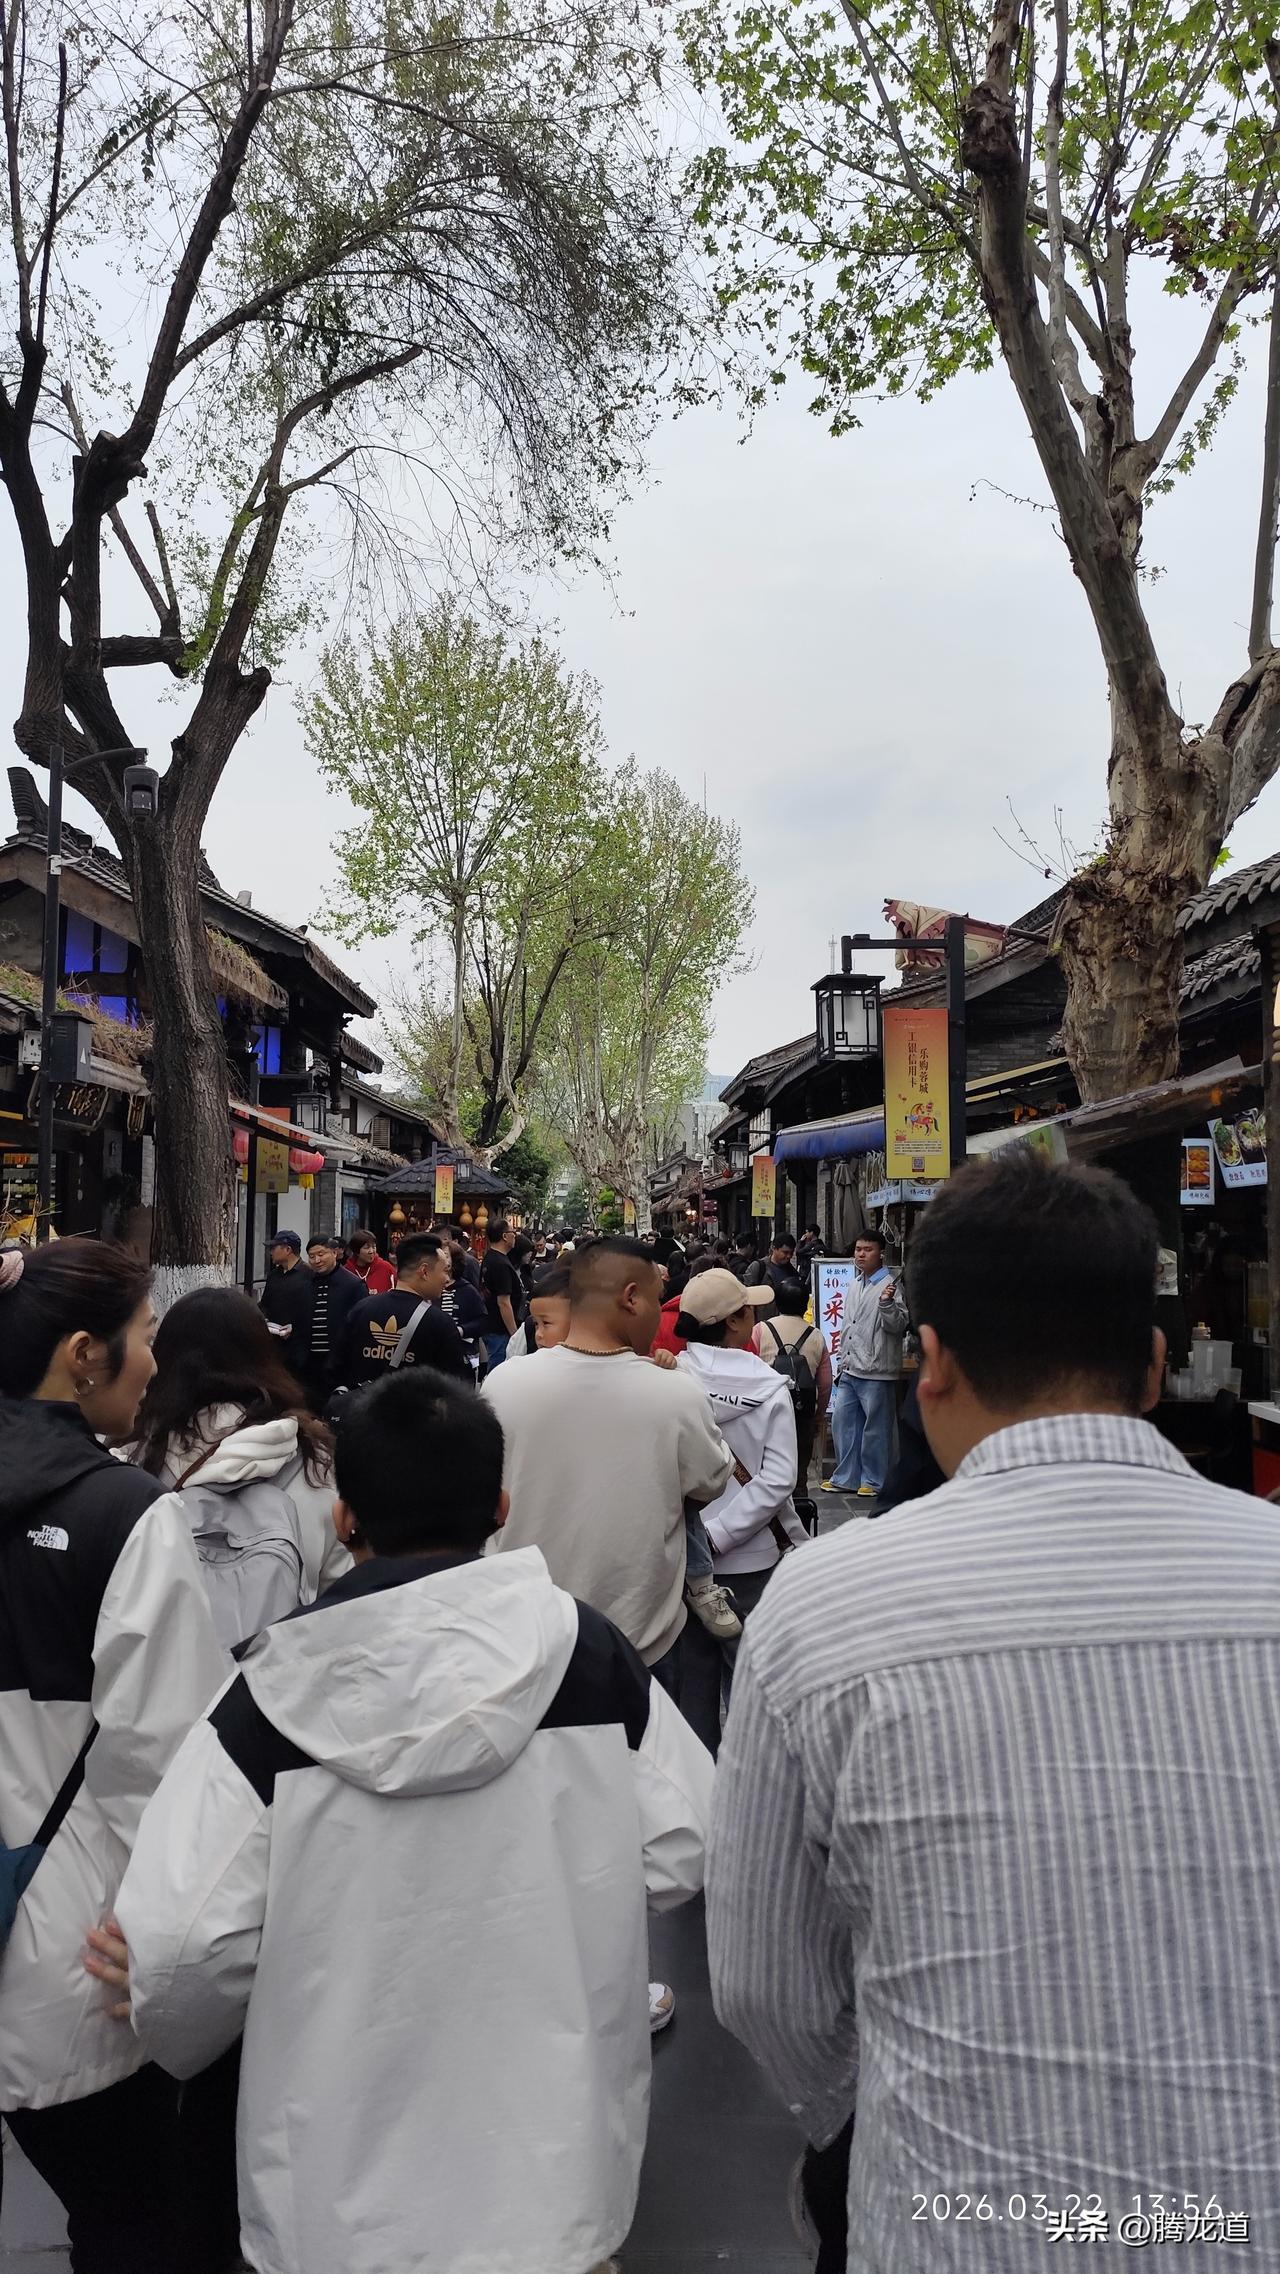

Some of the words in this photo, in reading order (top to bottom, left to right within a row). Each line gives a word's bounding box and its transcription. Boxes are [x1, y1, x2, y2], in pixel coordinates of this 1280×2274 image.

[908, 1031, 917, 1088] 工银信用卡
[919, 1047, 929, 1094] 乐购蓉城
[362, 1345, 415, 1363] adids
[27, 1530, 57, 1541] NORTH
[42, 1525, 58, 1535] THE
[33, 1539, 55, 1549] FACE
